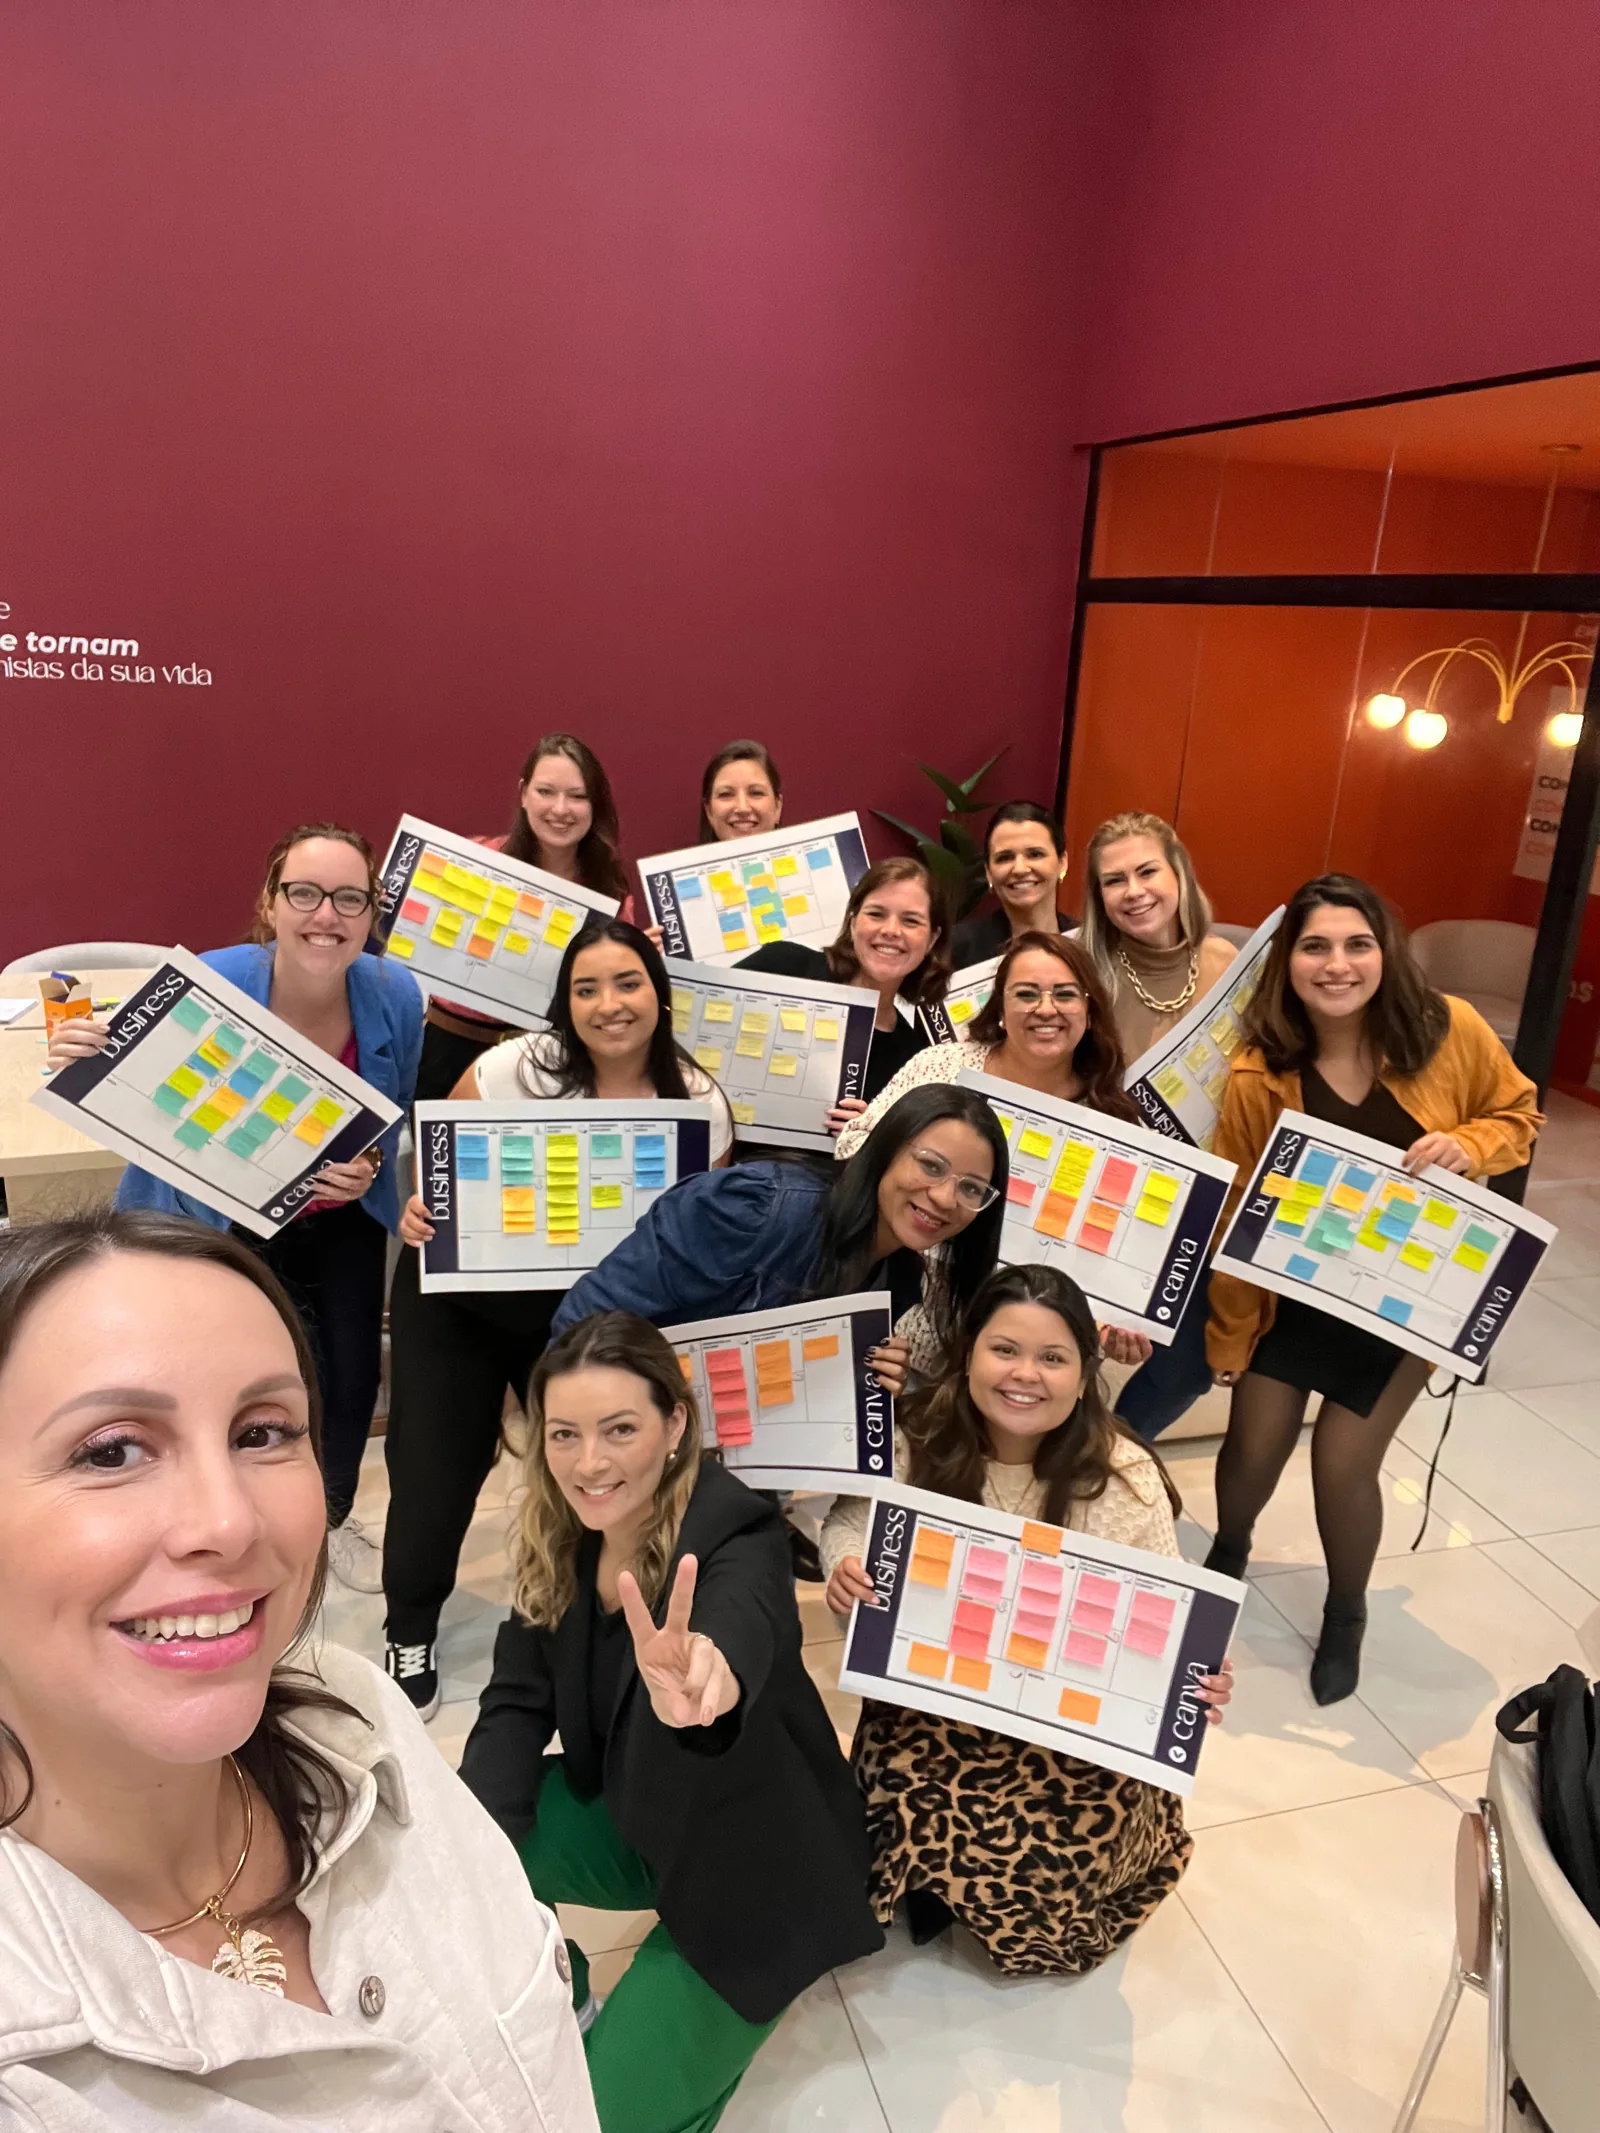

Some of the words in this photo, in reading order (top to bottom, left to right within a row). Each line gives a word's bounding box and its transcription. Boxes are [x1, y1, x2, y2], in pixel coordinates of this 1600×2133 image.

[25, 631, 139, 657] tornam
[71, 657, 104, 681] da
[110, 664, 156, 683] sua
[162, 662, 212, 686] vida
[654, 874, 686, 955] business
[98, 973, 185, 1059] business
[429, 1123, 450, 1220] business
[1246, 1133, 1301, 1217] buness
[1162, 1238, 1199, 1303] canva
[1471, 1286, 1513, 1342] canva
[864, 1508, 907, 1612] business
[1173, 1662, 1210, 1740] canva
